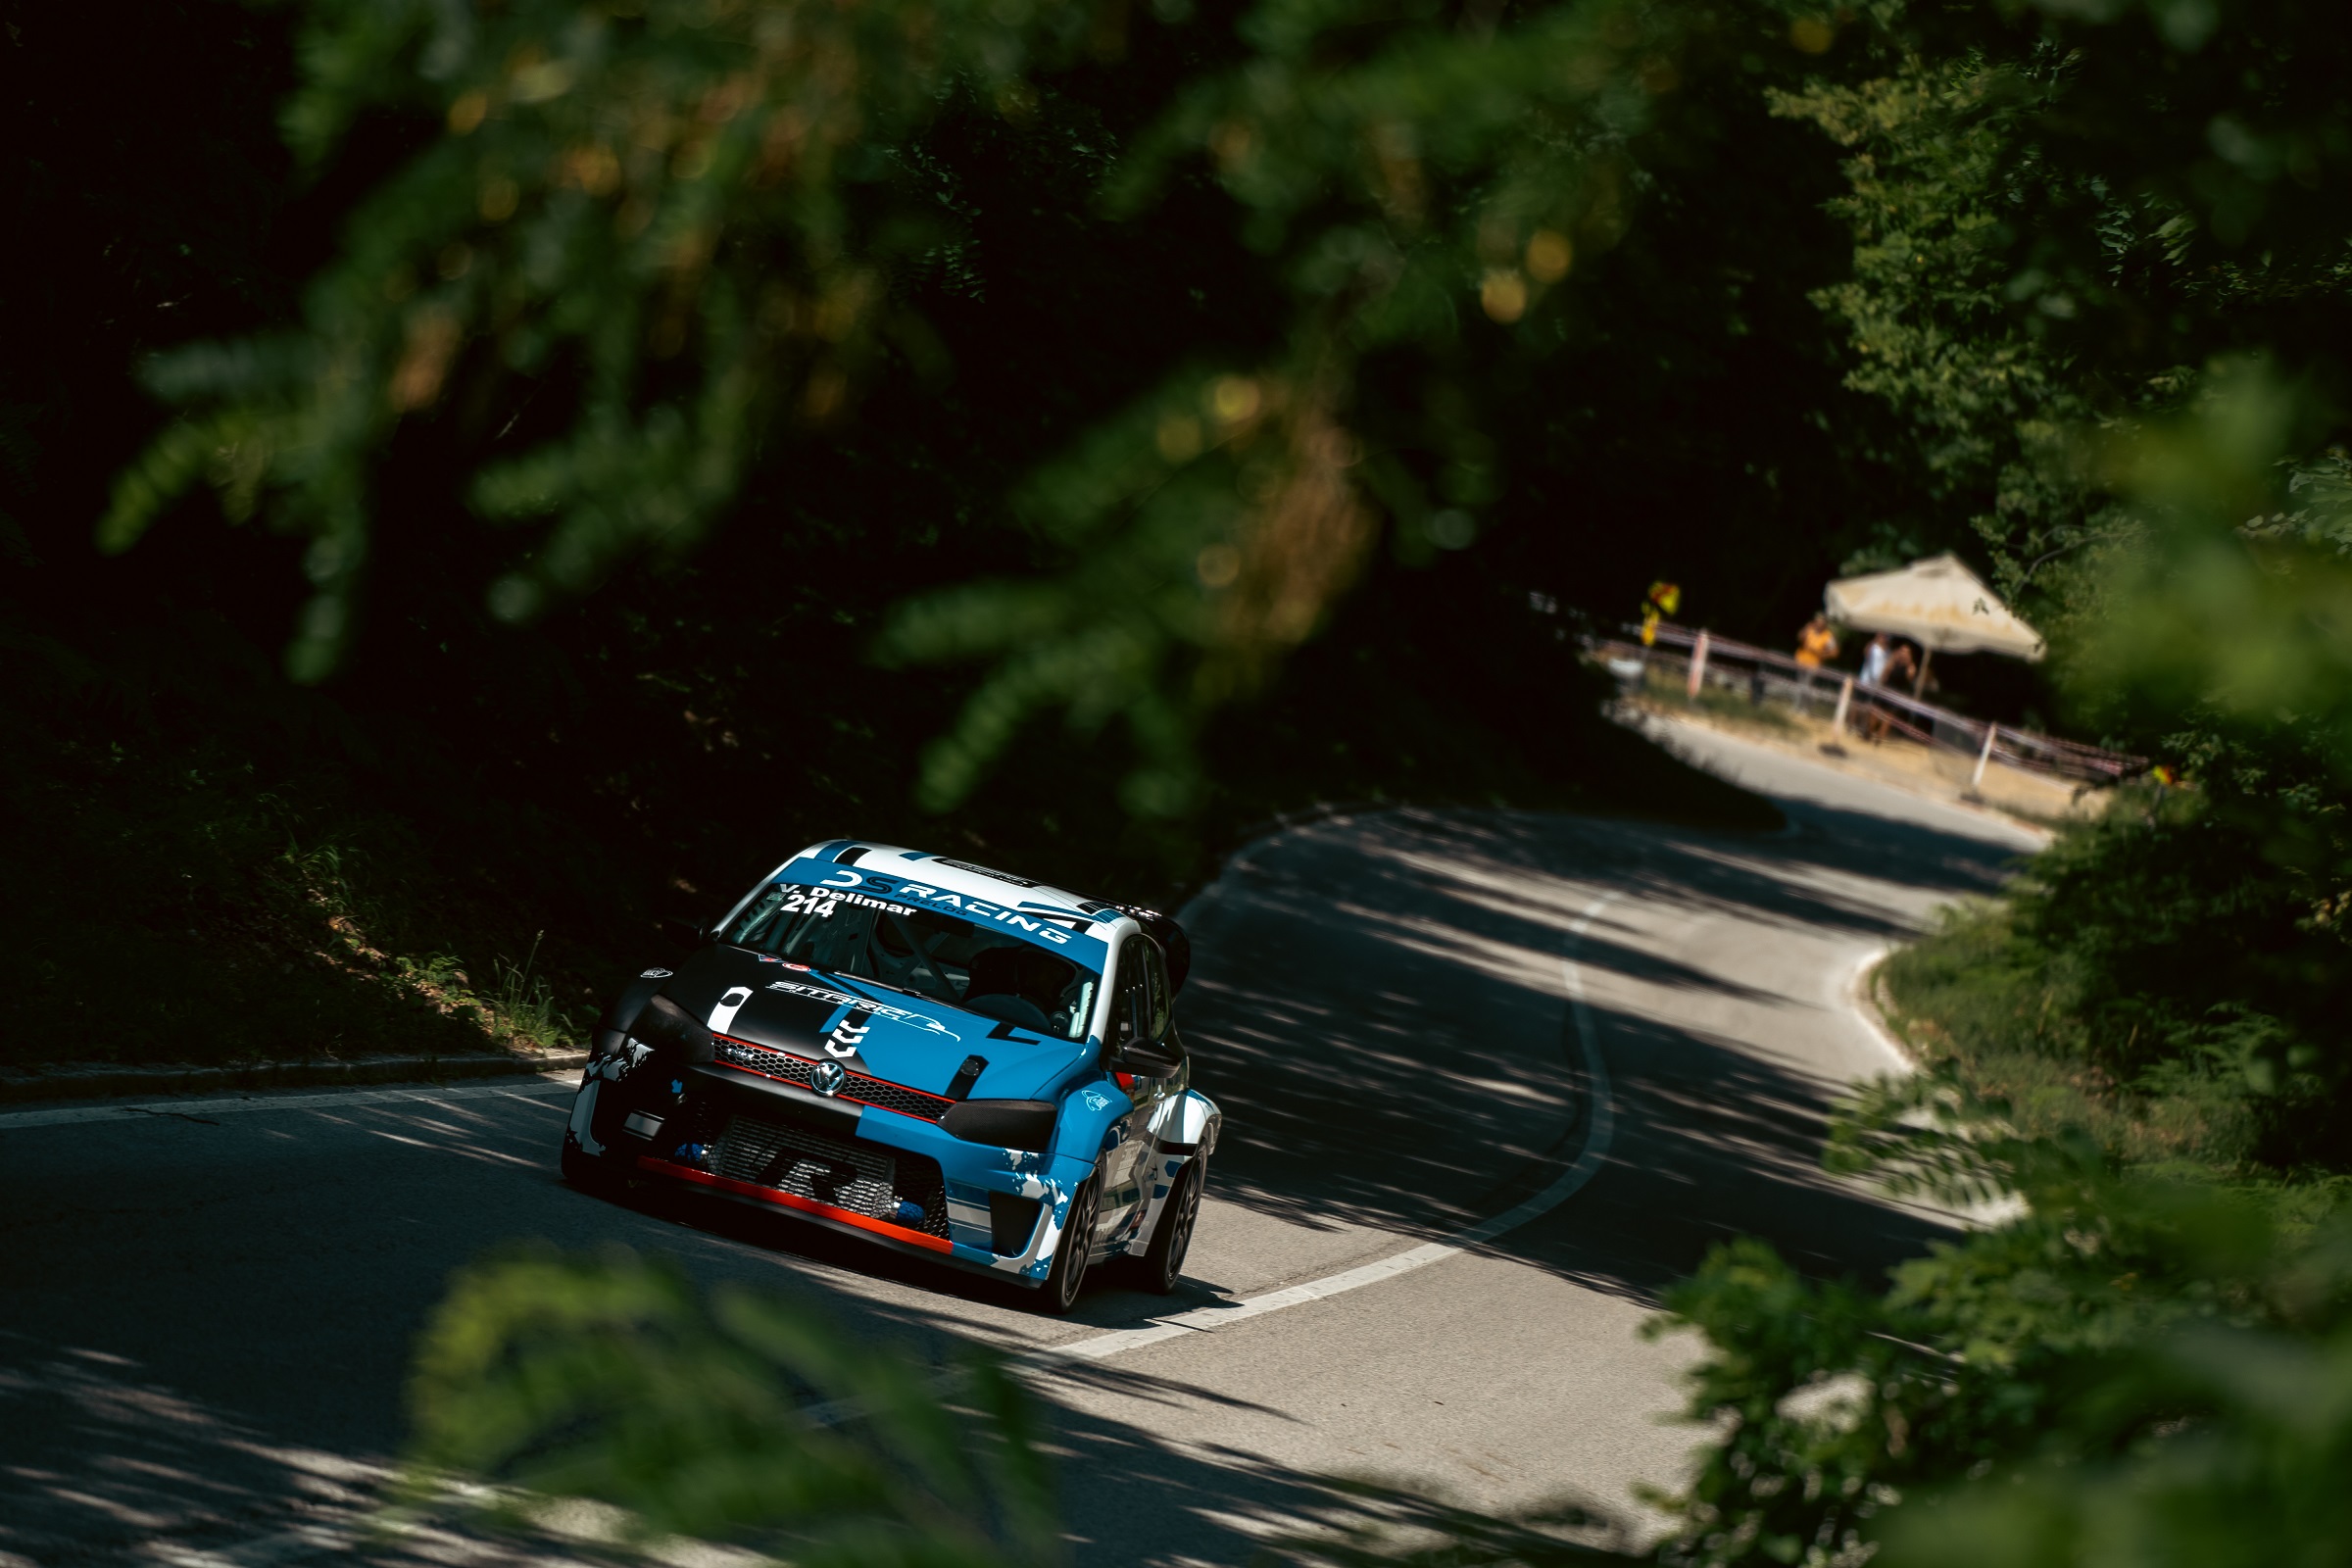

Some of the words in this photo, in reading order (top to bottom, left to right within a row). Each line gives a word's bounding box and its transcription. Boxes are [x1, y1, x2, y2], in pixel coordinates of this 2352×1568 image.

[780, 884, 801, 895] V.
[809, 886, 917, 916] Delimar
[780, 894, 838, 918] 214
[894, 893, 969, 916] PRELOG
[899, 884, 1072, 945] RACING
